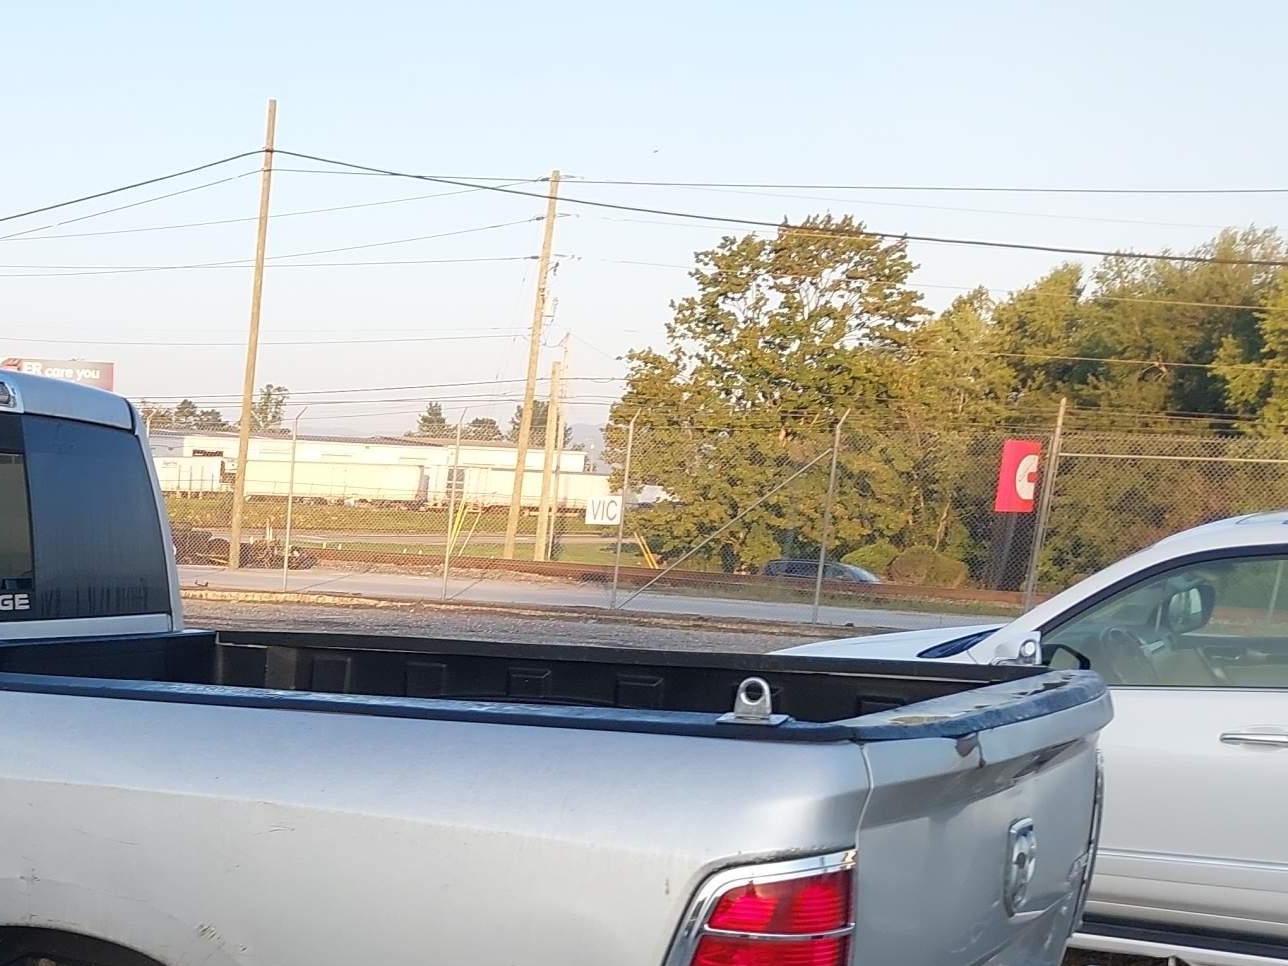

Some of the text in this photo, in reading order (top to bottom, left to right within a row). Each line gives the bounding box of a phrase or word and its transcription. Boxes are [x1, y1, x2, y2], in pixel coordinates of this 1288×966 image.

[45, 367, 73, 379] care
[76, 368, 100, 381] you
[591, 499, 618, 521] VIC
